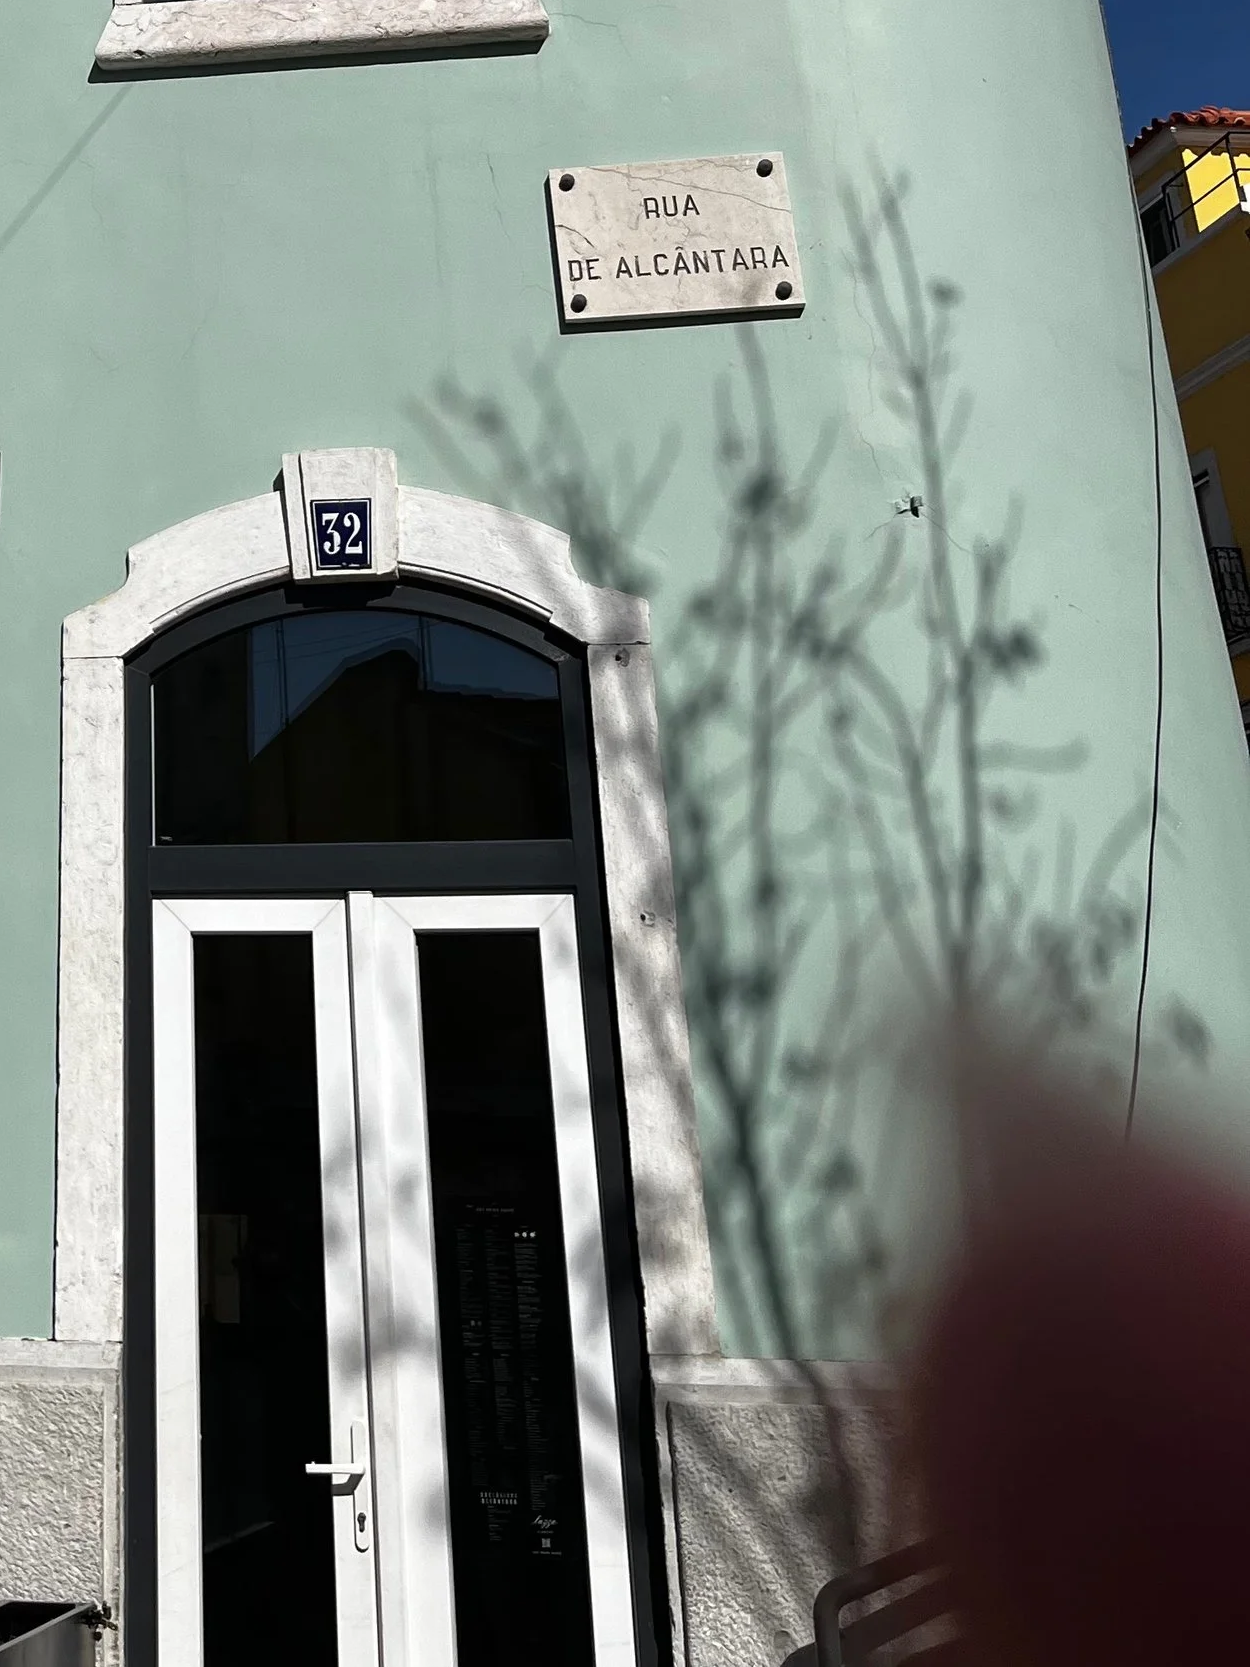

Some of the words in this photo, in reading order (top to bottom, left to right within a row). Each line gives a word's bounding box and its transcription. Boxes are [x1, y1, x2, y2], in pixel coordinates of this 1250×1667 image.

[642, 194, 700, 220] RUA
[567, 258, 602, 282] DE
[615, 245, 790, 280] ALCÂNTARA
[321, 512, 363, 555] 32
